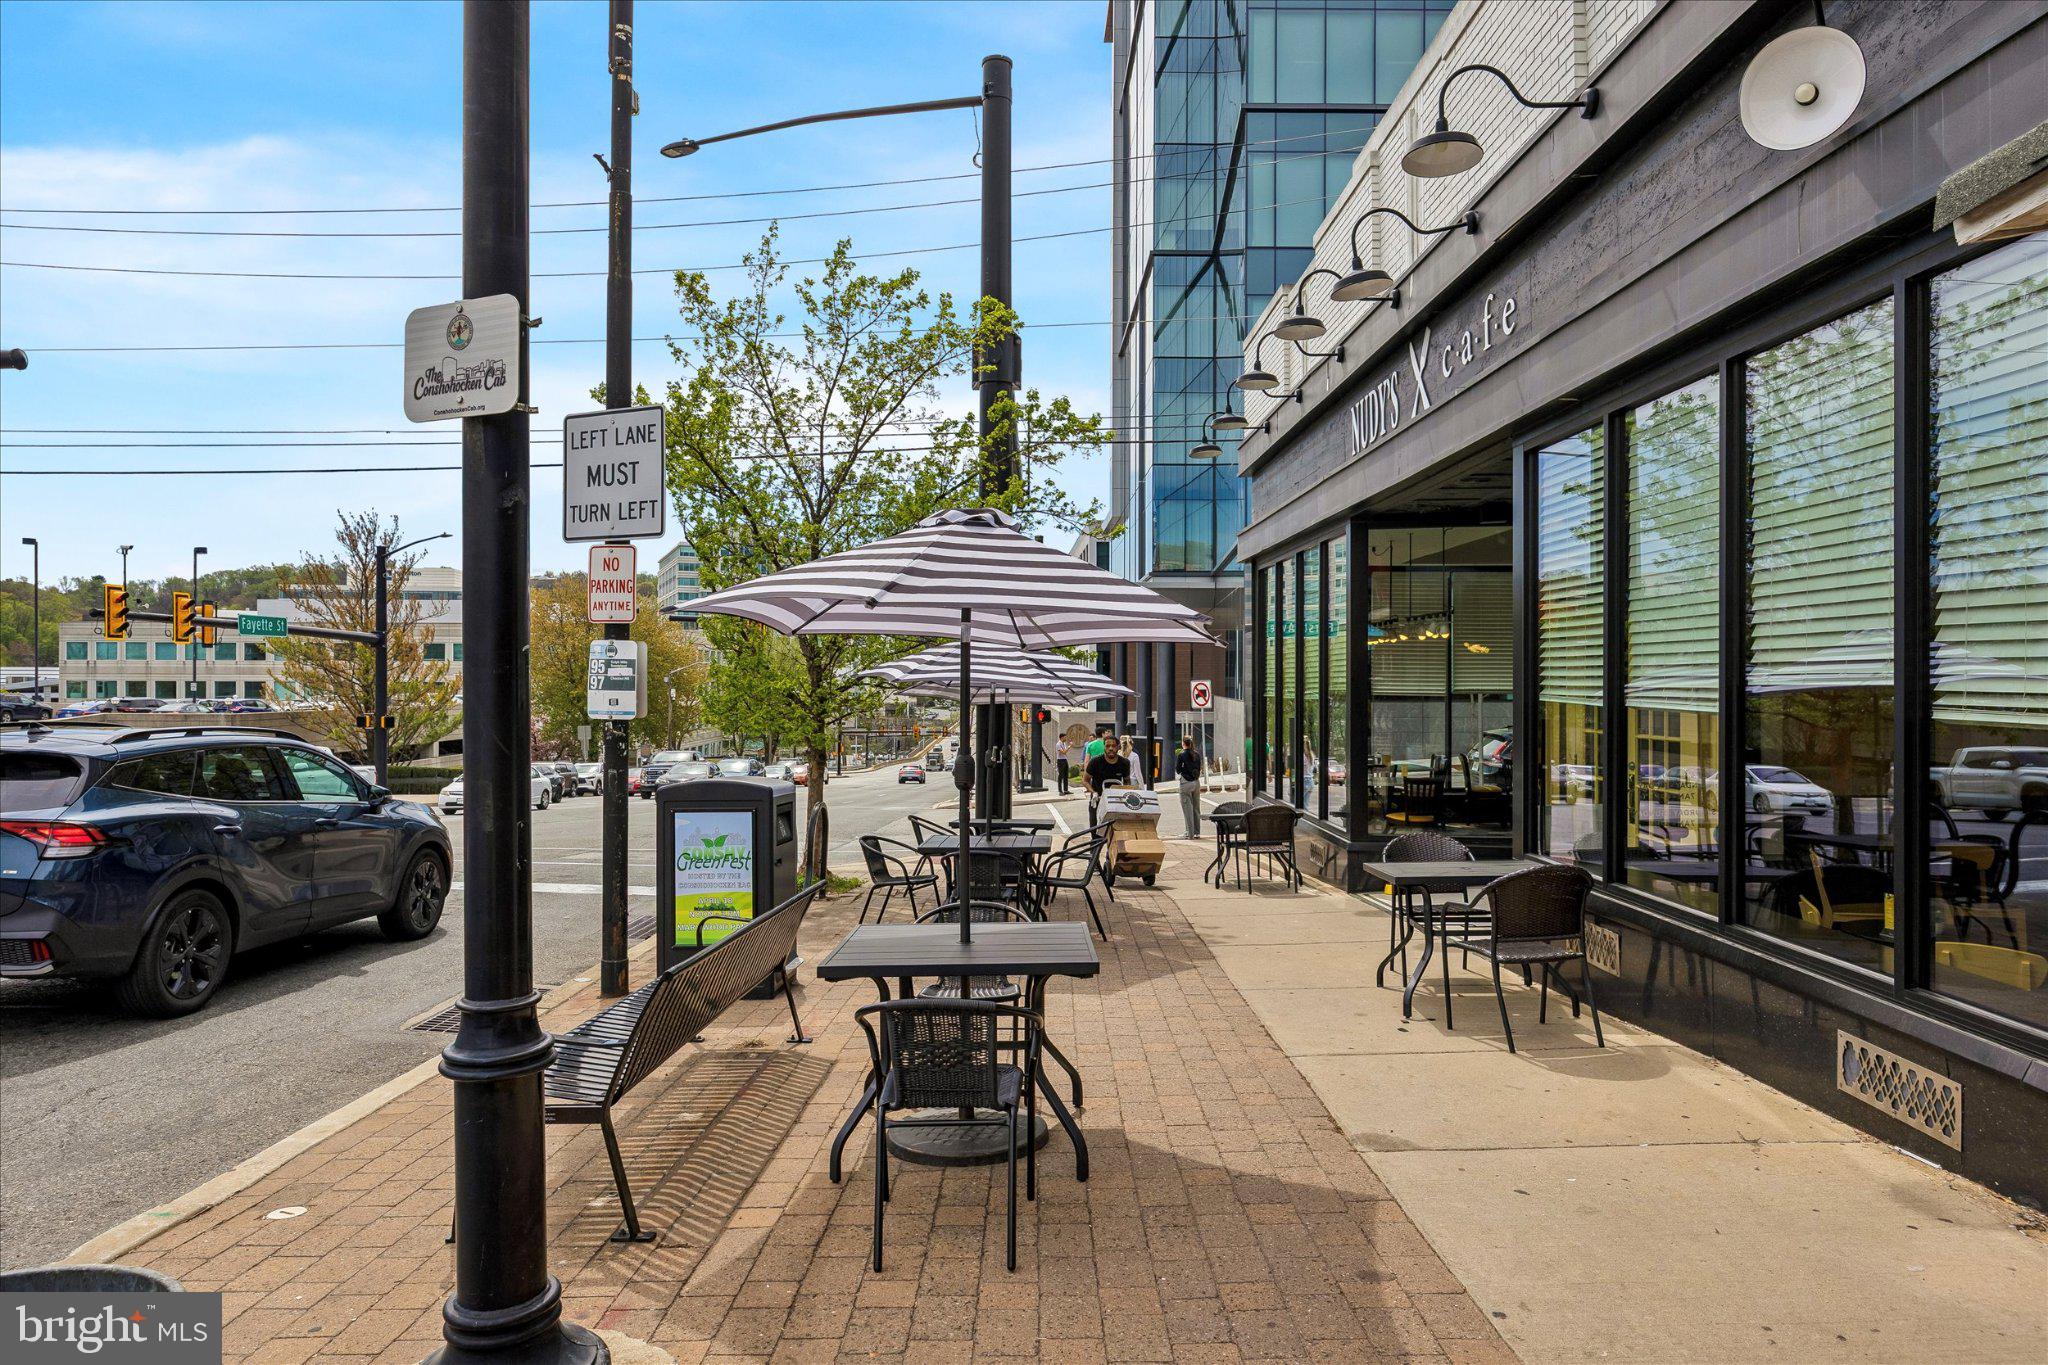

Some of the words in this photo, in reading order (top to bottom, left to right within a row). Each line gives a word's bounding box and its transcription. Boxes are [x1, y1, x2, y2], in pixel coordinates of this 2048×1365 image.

[414, 371, 482, 401] Conshohocken
[484, 365, 507, 391] Cab
[425, 366, 443, 385] The
[433, 404, 486, 416] ConshohockenCab.org
[1351, 370, 1400, 457] NUDY'S
[571, 429, 608, 450] LEFT
[615, 424, 657, 446] LANE
[587, 461, 640, 488] MUST
[570, 503, 610, 523] TURN
[618, 500, 658, 521] LEFT
[602, 557, 620, 572] NO
[591, 579, 633, 594] PARKING
[592, 601, 631, 612] ANYTIME
[241, 617, 273, 634] Fayette
[276, 619, 285, 632] St
[590, 659, 606, 674] 95
[590, 675, 605, 691] 97
[677, 850, 752, 872] GreenFest
